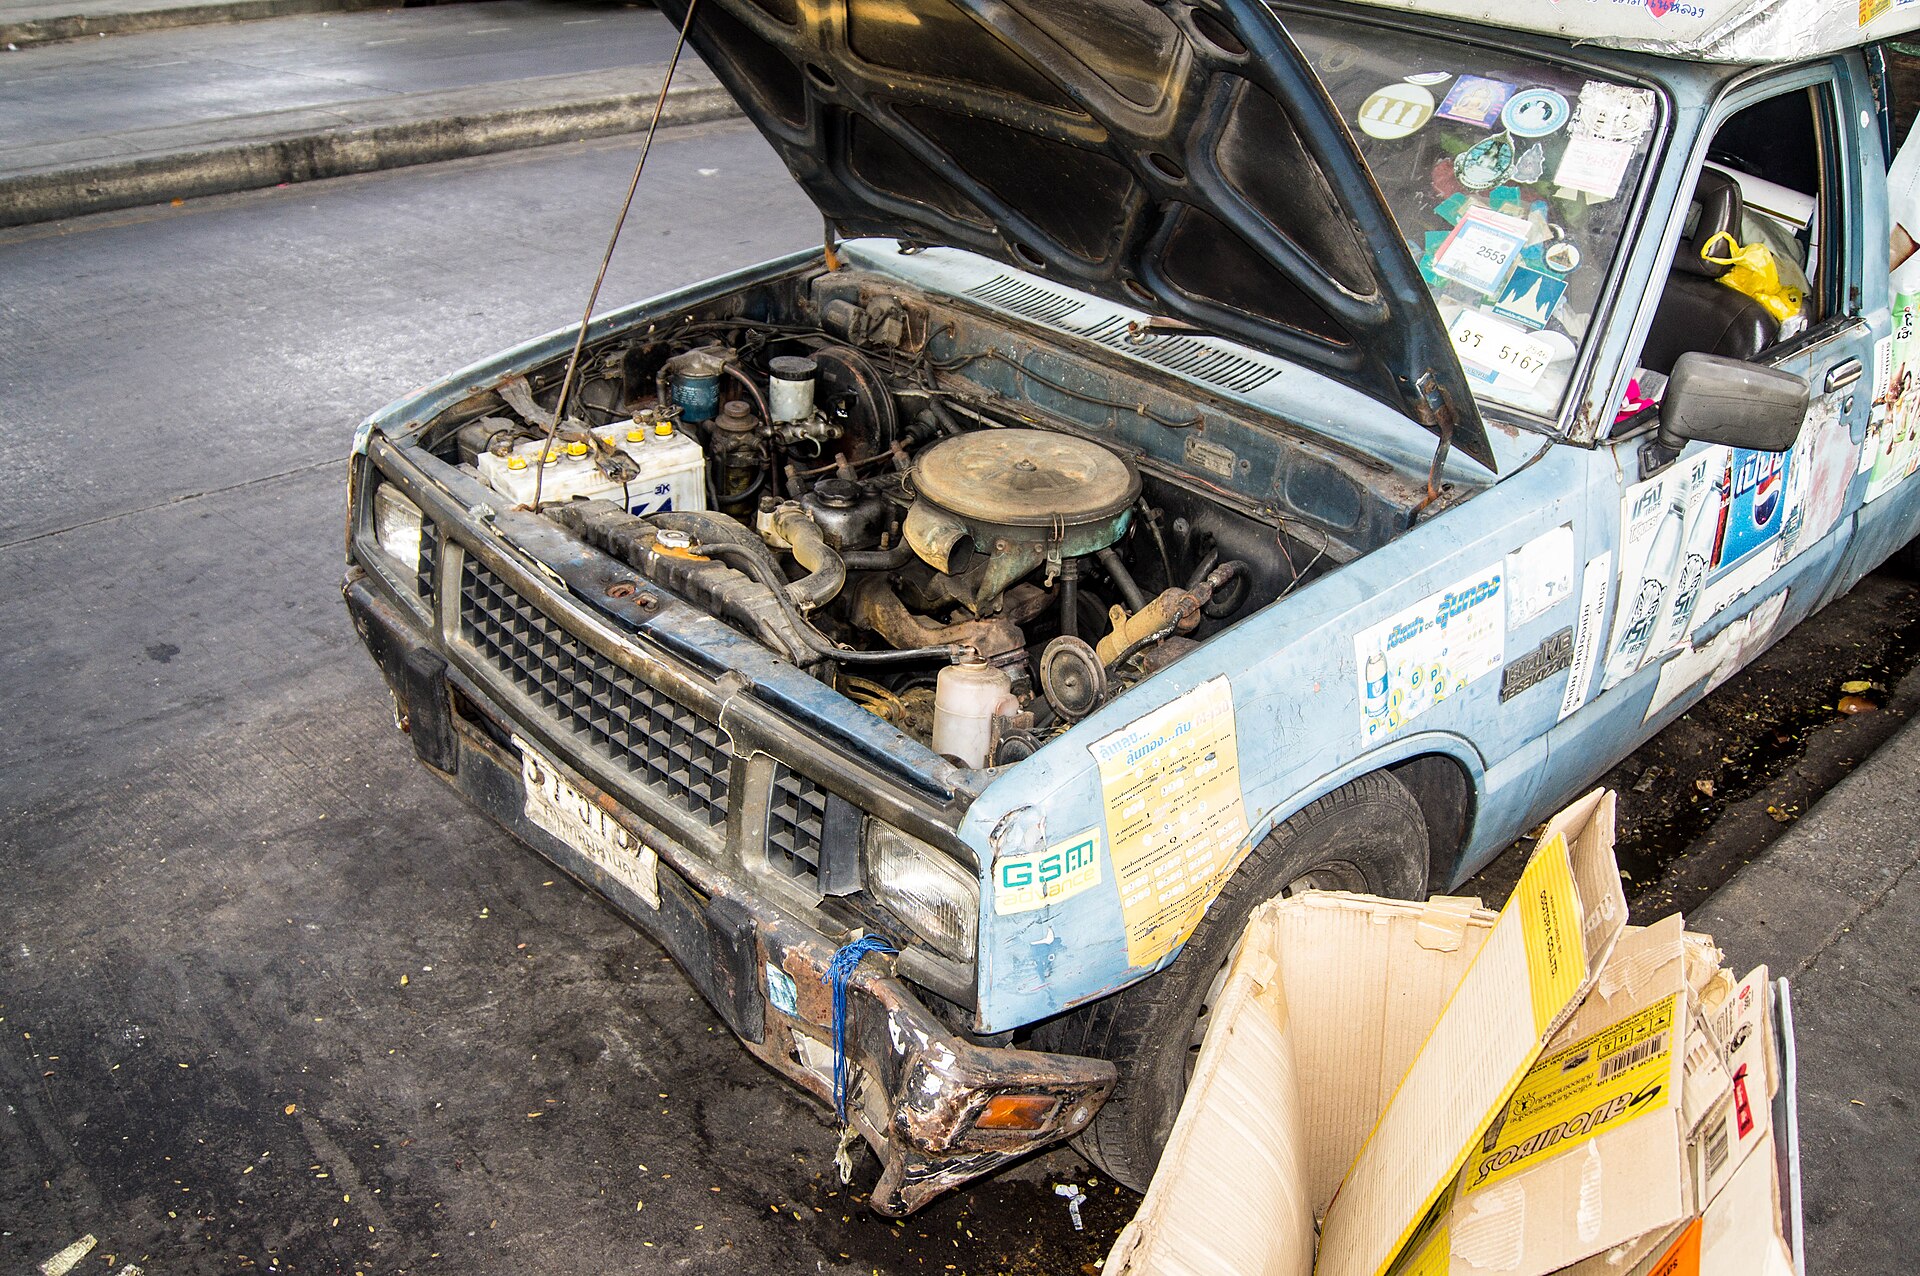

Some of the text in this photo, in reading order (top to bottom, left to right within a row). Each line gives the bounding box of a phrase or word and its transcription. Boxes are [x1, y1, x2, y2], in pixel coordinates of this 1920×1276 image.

[1476, 245, 1507, 265] 2553
[1498, 345, 1544, 374] 5167
[654, 483, 671, 495] 3K
[1002, 839, 1094, 888] GSM
[1472, 1091, 1634, 1187] สปอนเซอร์
